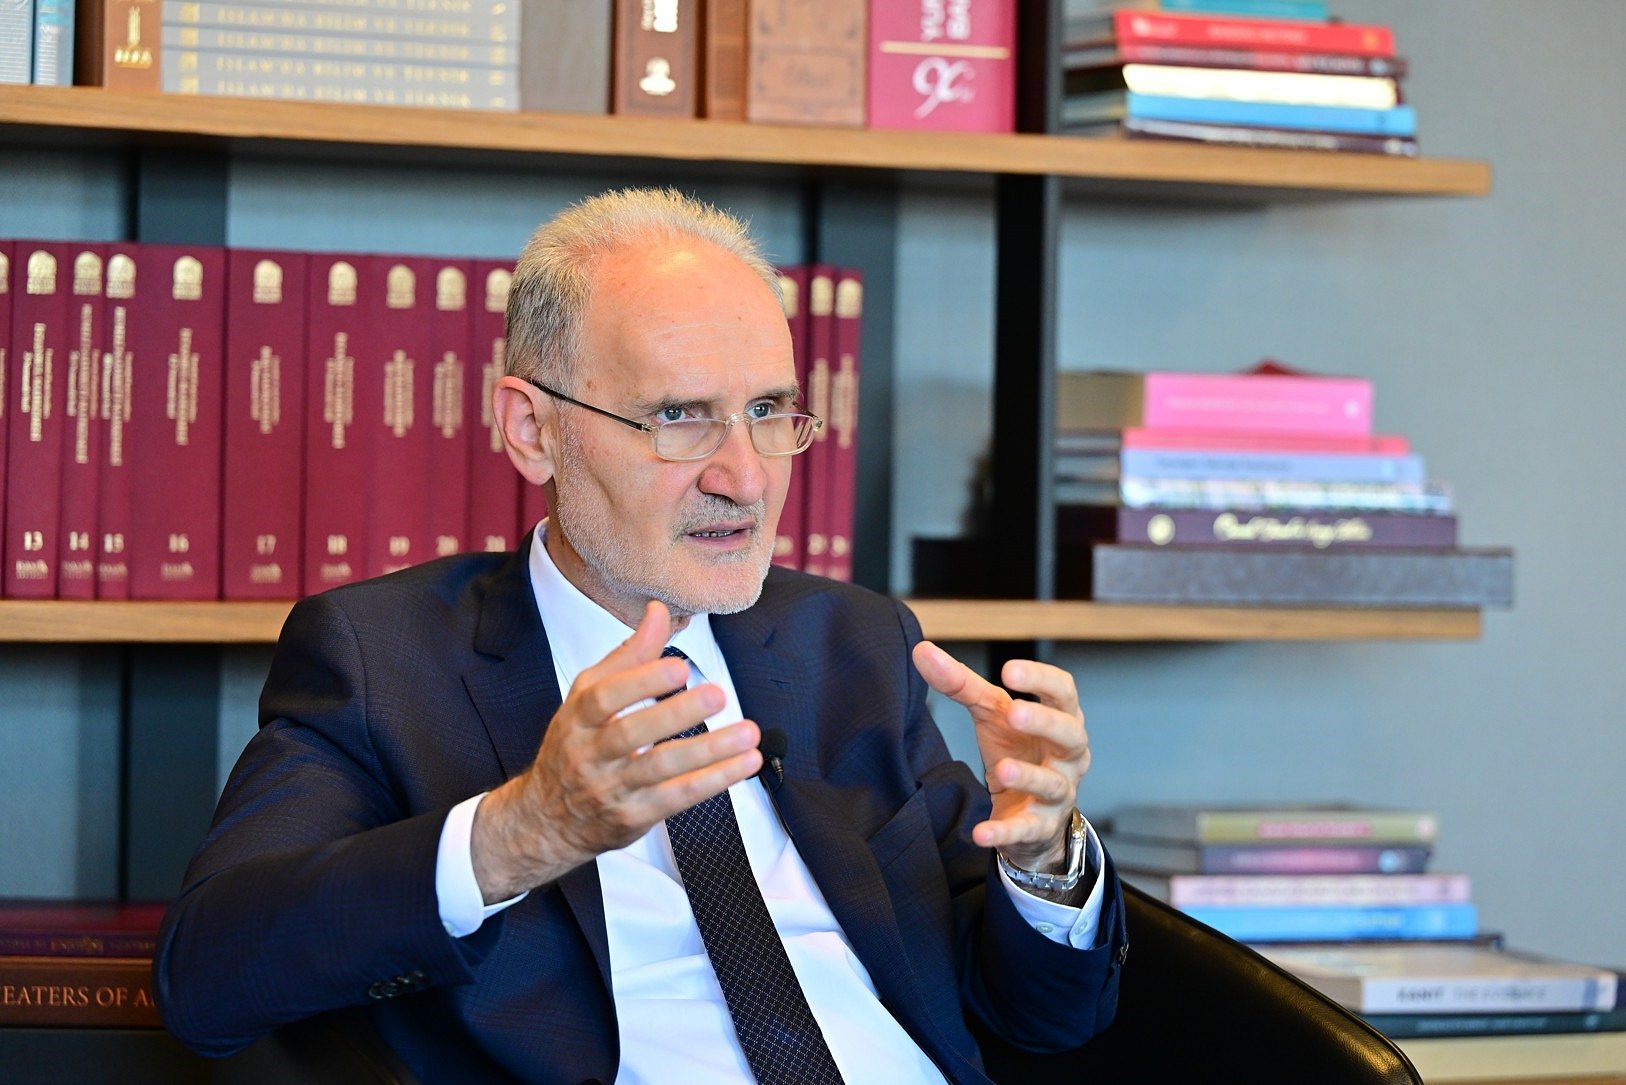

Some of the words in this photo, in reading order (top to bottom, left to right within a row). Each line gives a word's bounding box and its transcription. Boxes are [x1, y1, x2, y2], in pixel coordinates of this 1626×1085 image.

[946, 0, 971, 40] BA
[24, 531, 44, 551] 13
[69, 531, 90, 551] 14
[104, 533, 125, 553] 15
[168, 533, 190, 553] 16
[257, 534, 277, 555] 17
[0, 985, 89, 1008] EATERS
[95, 986, 128, 1008] OF
[134, 988, 156, 1008] A
